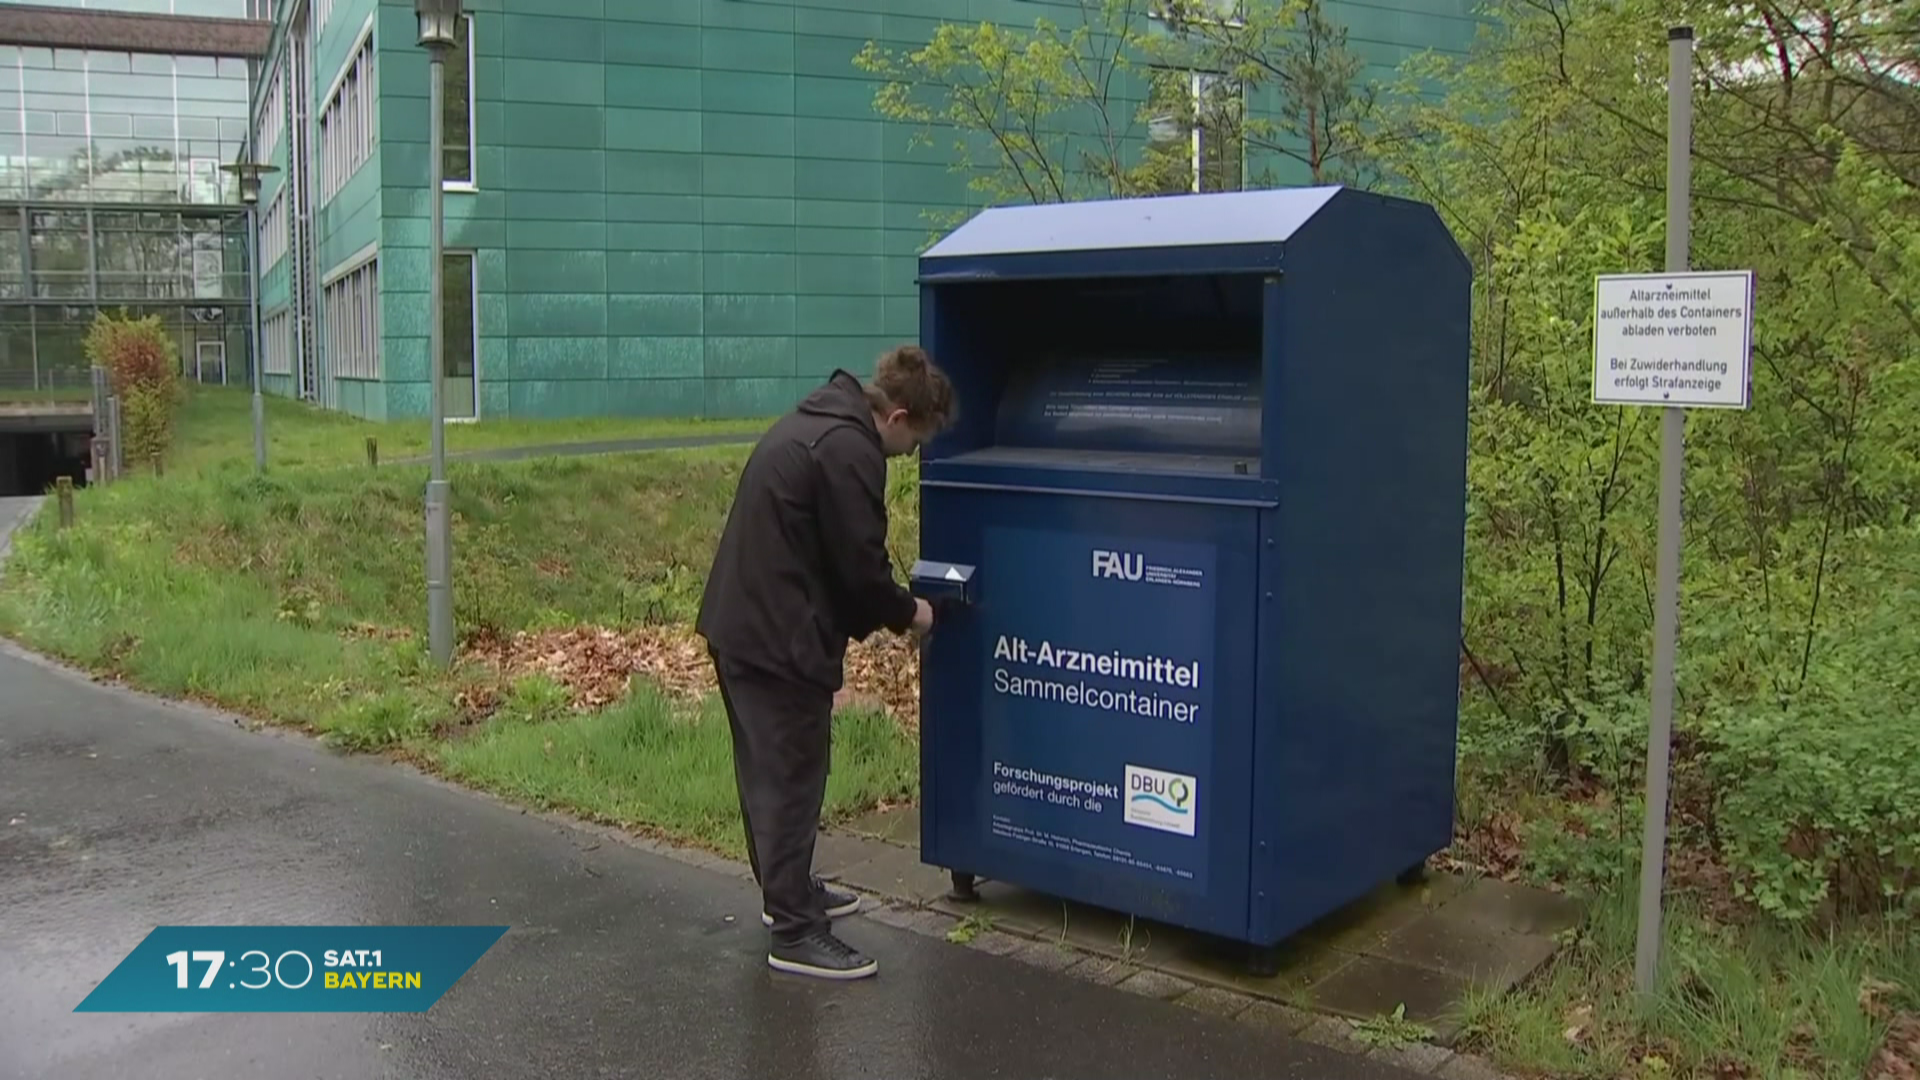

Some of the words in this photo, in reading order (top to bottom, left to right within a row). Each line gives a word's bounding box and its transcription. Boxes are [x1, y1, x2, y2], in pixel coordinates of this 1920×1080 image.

[1629, 288, 1711, 301] Altarzneimittel
[1600, 306, 1654, 319] außerhalb
[1658, 306, 1677, 318] des
[1680, 306, 1742, 318] Containers
[1622, 325, 1664, 336] abladen
[1668, 325, 1717, 336] verboten
[1610, 358, 1627, 370] Bei
[1630, 358, 1728, 375] Zuwiderhandlung
[1614, 375, 1649, 391] erfolgt
[1652, 376, 1721, 392] Strafanzeige
[1093, 550, 1143, 581] FAU
[994, 635, 1199, 688] Alt-Arzneimittel
[994, 669, 1199, 723] Sammelcontainer
[993, 762, 1119, 799] Forschungsprojekt
[1131, 773, 1165, 796] DBU
[993, 781, 1044, 800] gefördert
[1047, 790, 1080, 809] durch
[1084, 798, 1103, 813] die
